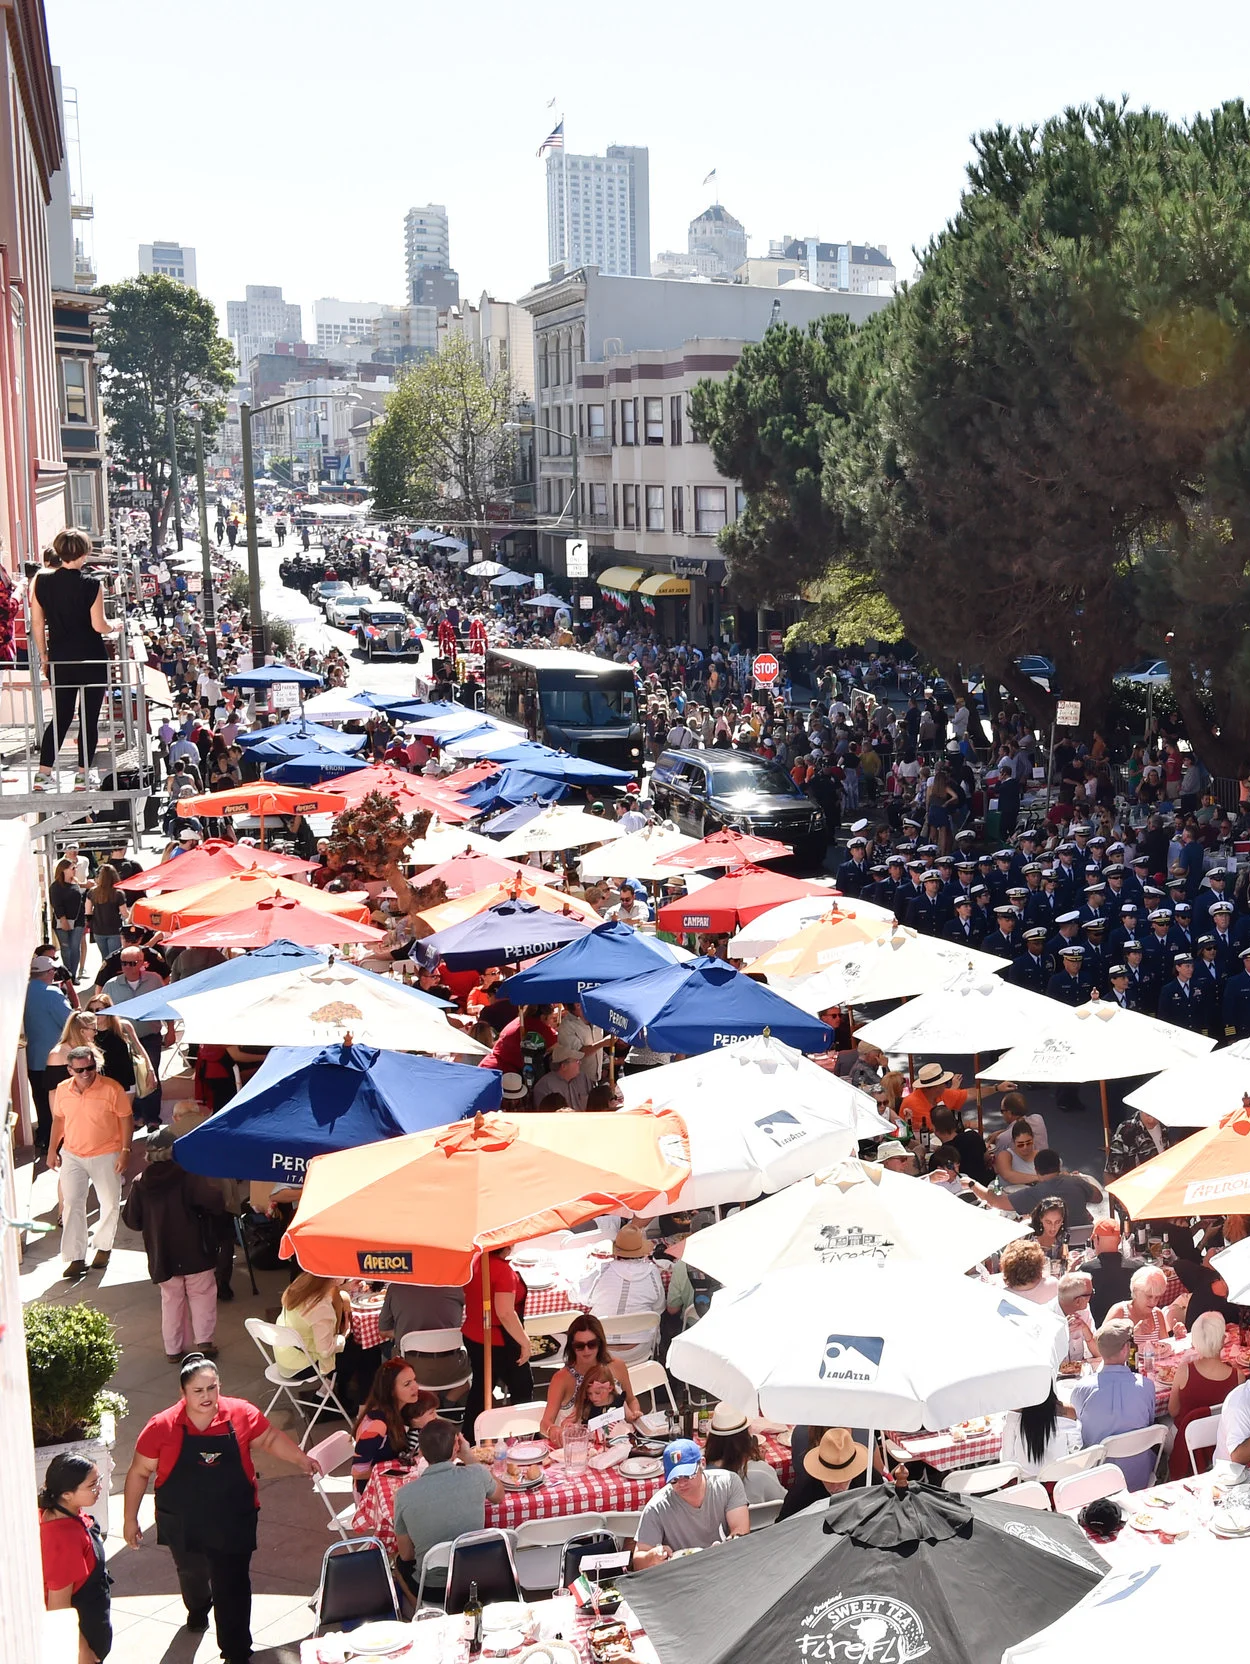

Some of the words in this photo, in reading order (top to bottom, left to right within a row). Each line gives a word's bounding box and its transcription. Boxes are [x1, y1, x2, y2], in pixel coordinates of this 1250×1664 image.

[670, 556, 708, 579] Original
[755, 662, 777, 674] STOP
[320, 764, 346, 772] PERONI
[224, 803, 247, 813] APEROL
[296, 803, 317, 813] APEROL
[683, 915, 710, 927] CAMPARI
[608, 1009, 630, 1030] PERONI
[286, 1174, 304, 1183] ITA
[1191, 1178, 1250, 1199] APEROL
[363, 1254, 409, 1270] APEROL
[827, 1369, 870, 1381] LAVAZZA
[827, 1600, 885, 1625] SWEET
[887, 1602, 912, 1630] TEA
